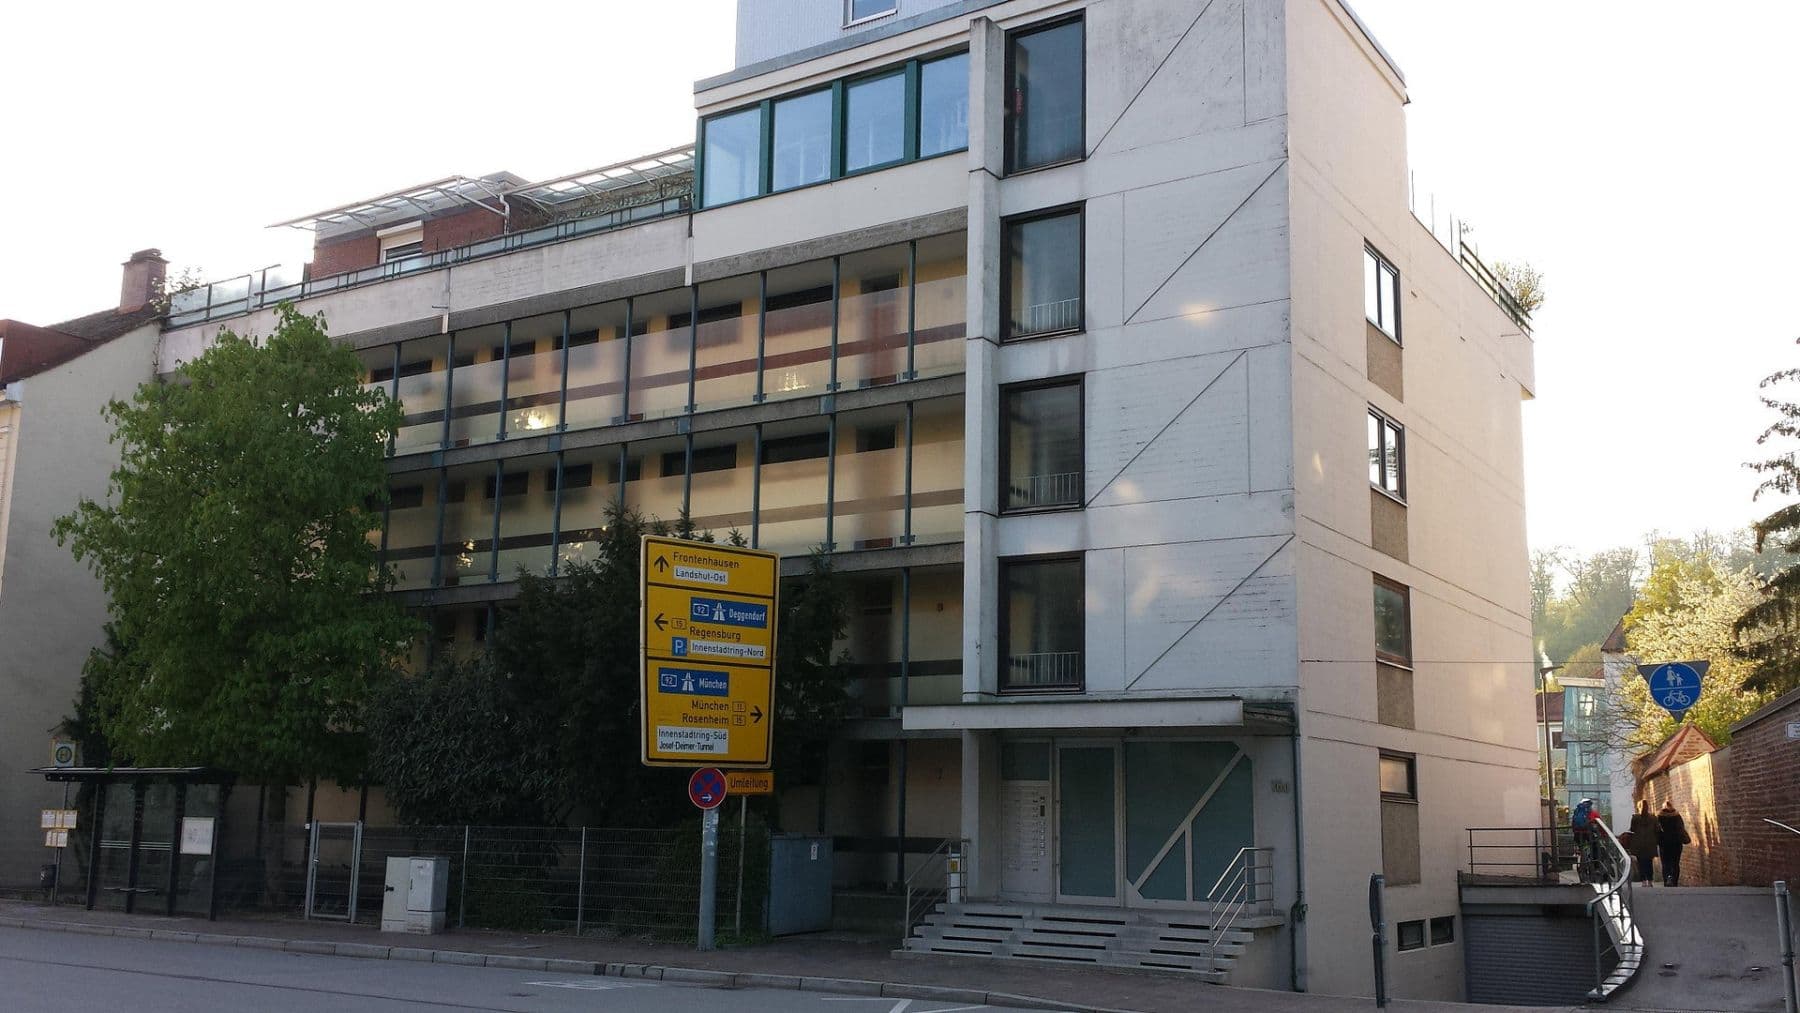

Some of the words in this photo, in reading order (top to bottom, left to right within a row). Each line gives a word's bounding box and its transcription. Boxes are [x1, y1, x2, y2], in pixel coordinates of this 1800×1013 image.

[673, 552, 740, 568] Frontenhausen
[676, 568, 726, 581] Landshut-Ost
[729, 608, 765, 622] Deggendorf
[690, 626, 741, 641] Regensburg
[675, 640, 684, 654] P
[693, 643, 764, 657] Innenstadtring-Nord
[699, 678, 727, 690] München
[692, 700, 729, 711] München
[682, 713, 729, 725] Rosenheim
[658, 728, 727, 741] Innenstadtring-Süd
[731, 777, 769, 791] Umleitung
